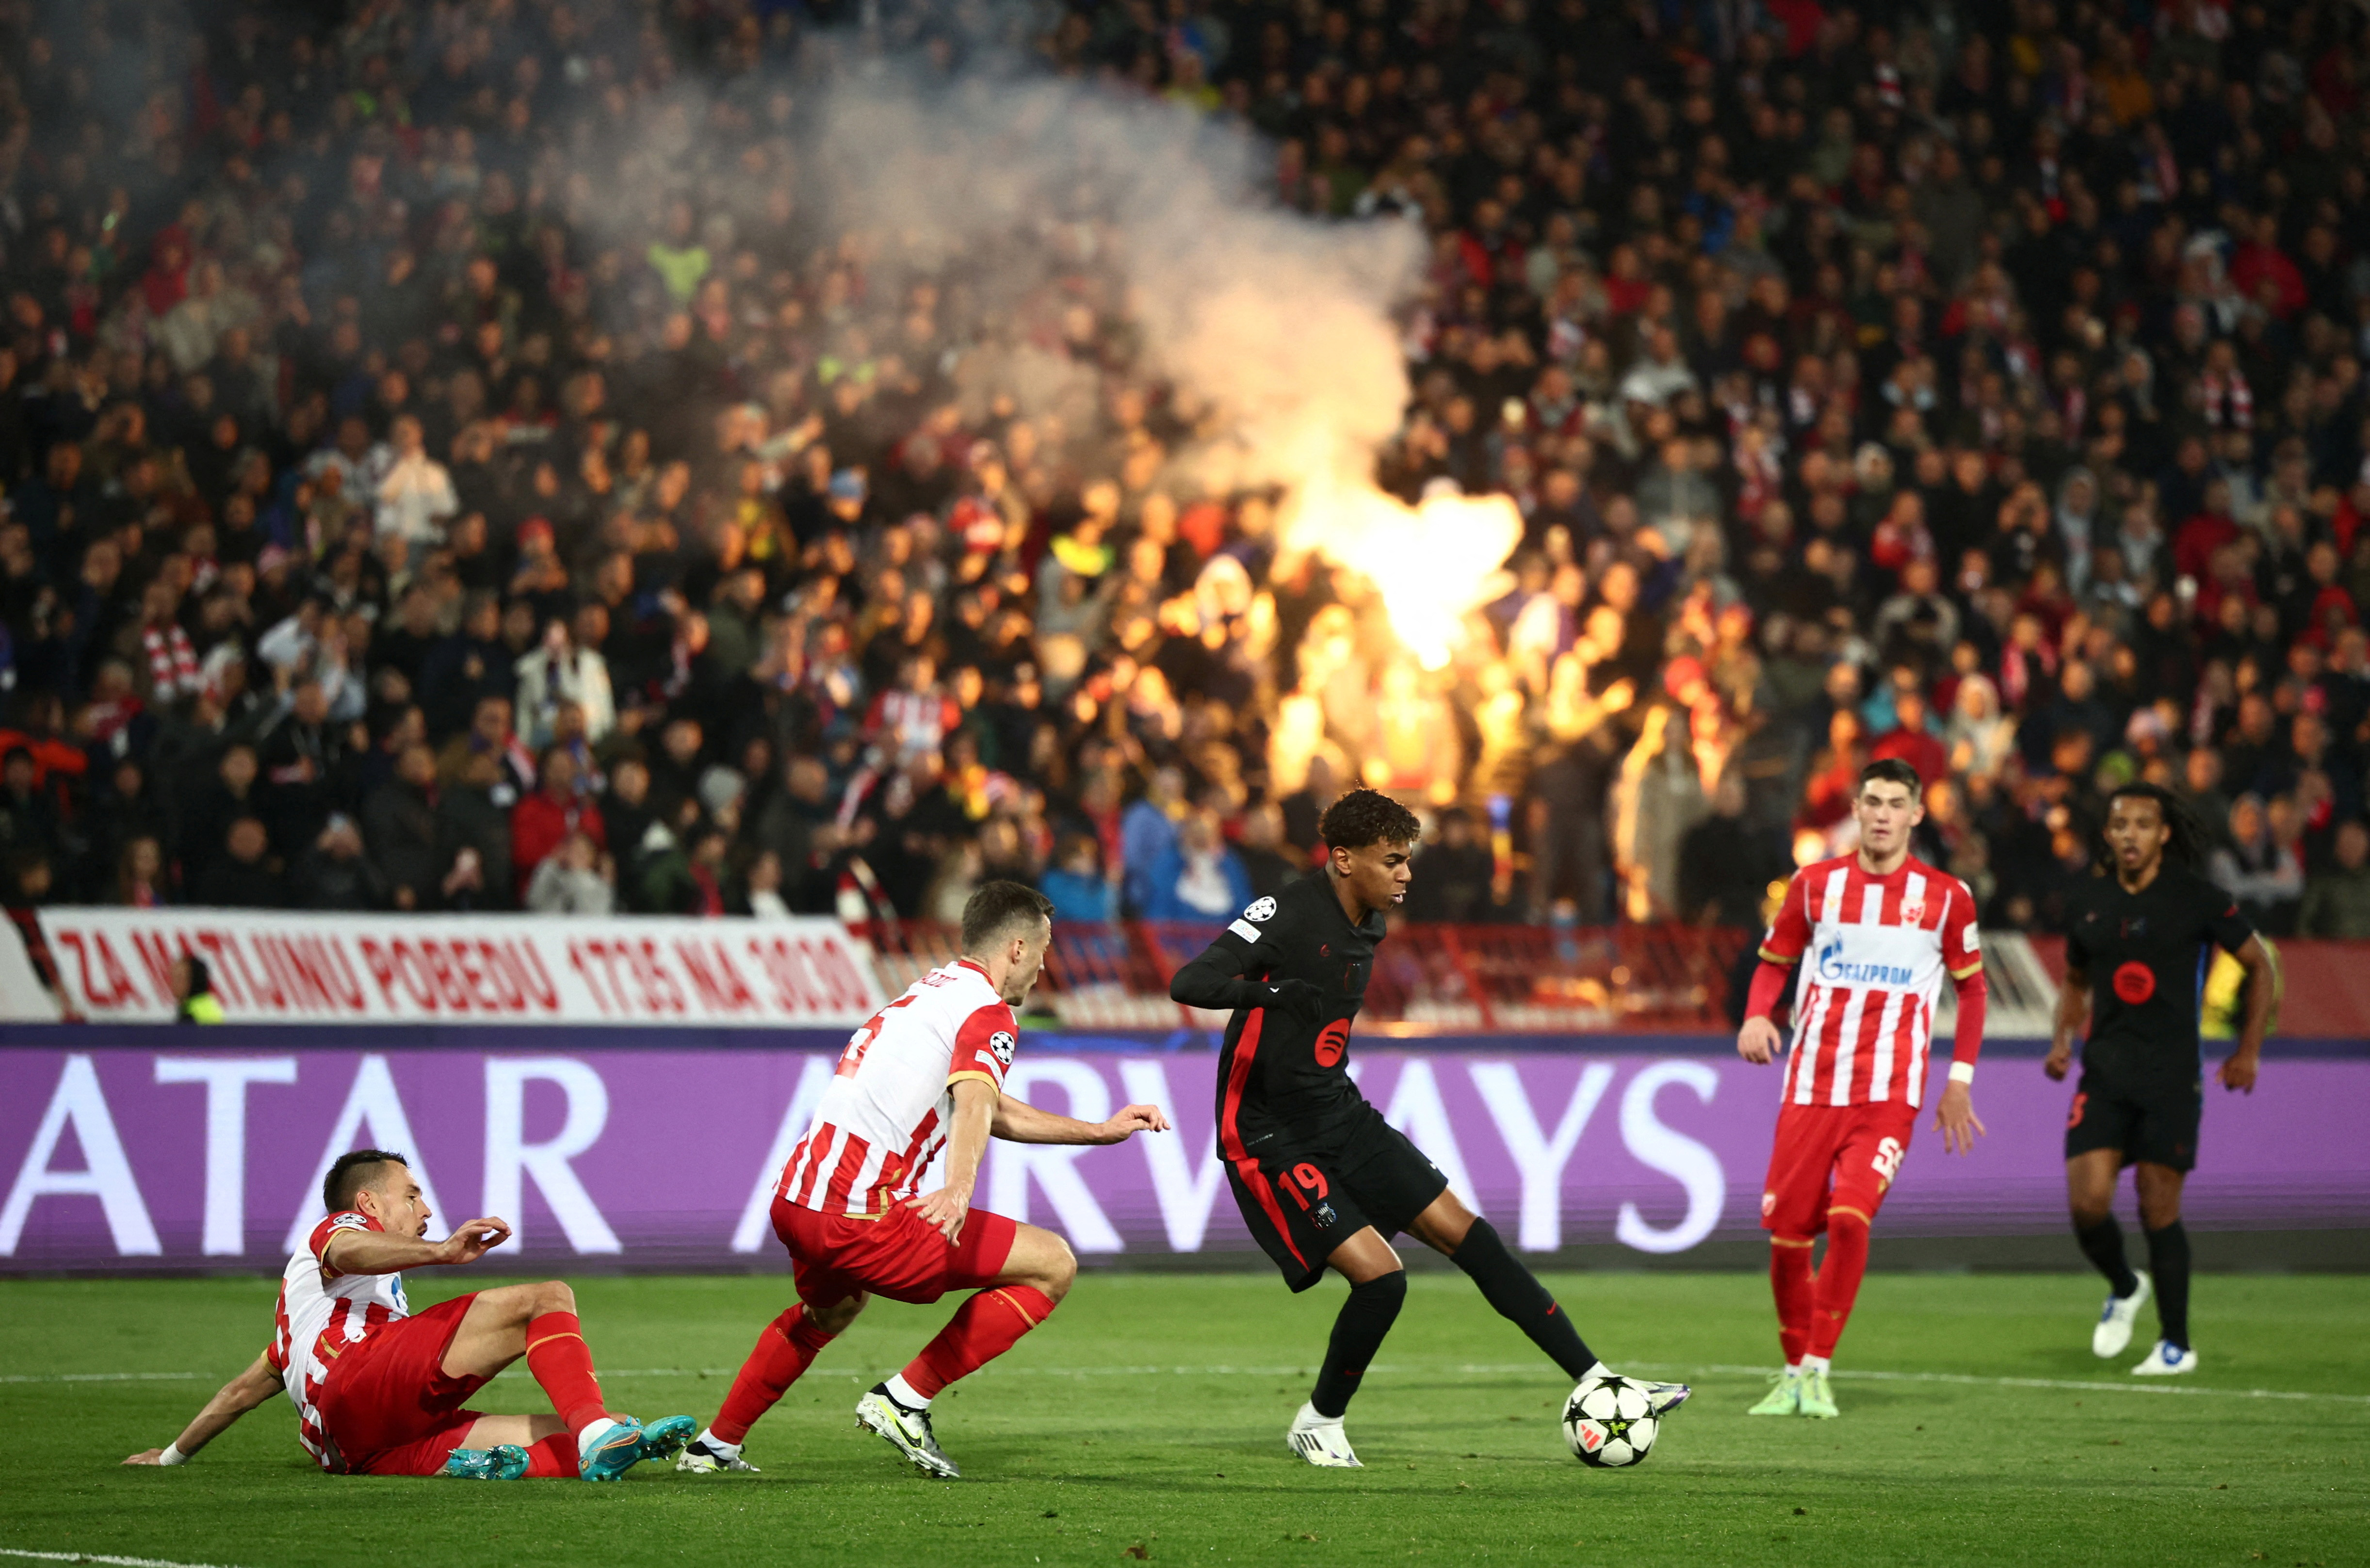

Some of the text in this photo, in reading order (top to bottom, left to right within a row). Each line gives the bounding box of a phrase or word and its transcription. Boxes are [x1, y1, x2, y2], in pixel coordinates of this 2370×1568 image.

[58, 928, 147, 1008] ZA
[358, 936, 561, 1012] POBEDU
[675, 938, 765, 1014] NA
[1278, 1163, 1329, 1212] 19
